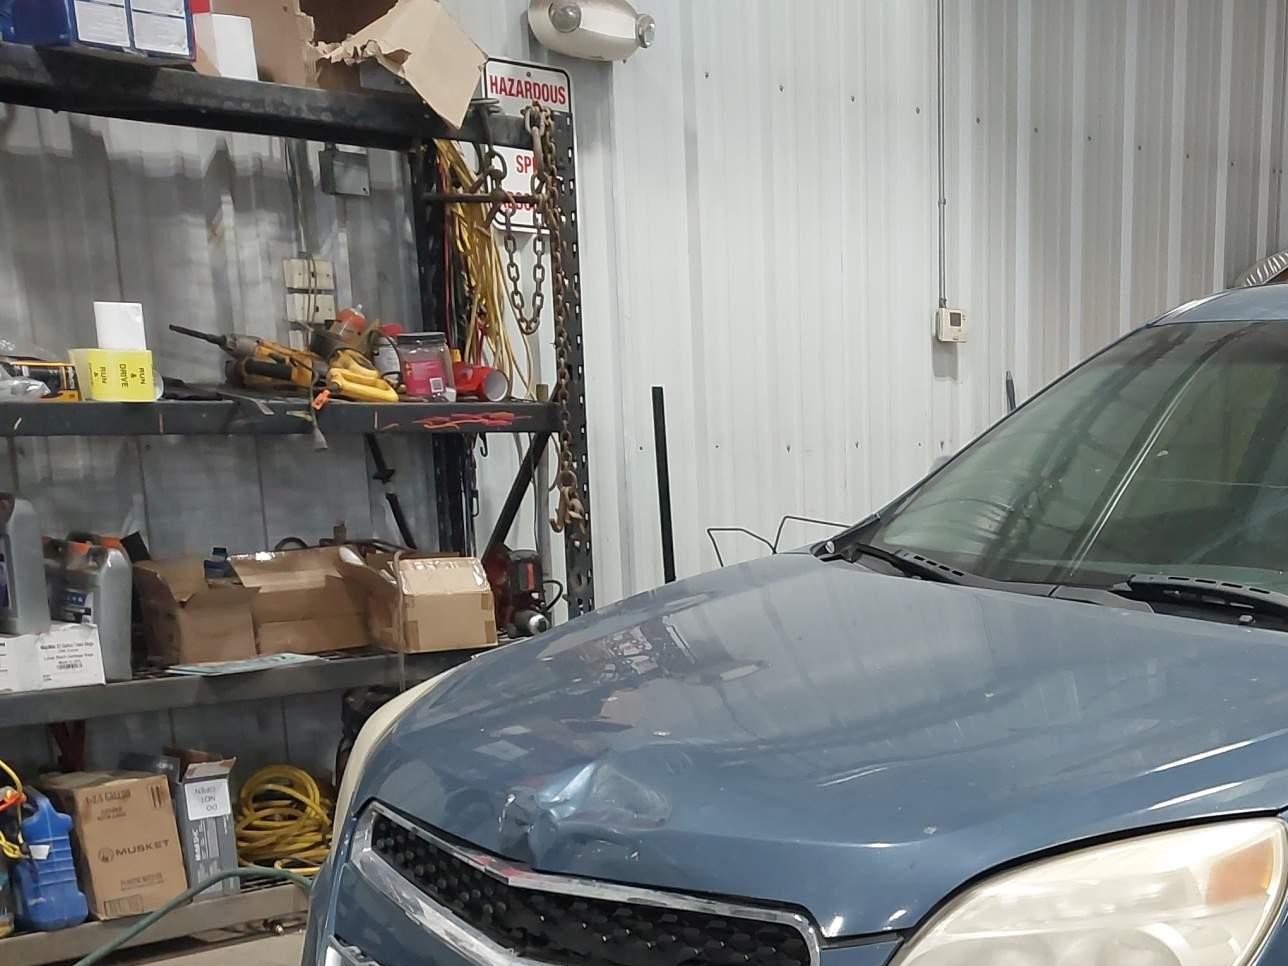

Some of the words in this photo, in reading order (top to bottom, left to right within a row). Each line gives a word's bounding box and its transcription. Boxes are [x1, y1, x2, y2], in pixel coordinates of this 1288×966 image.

[490, 75, 566, 105] HAZARDOUS
[120, 363, 129, 388] DRIVE
[115, 839, 169, 857] MUSKET
